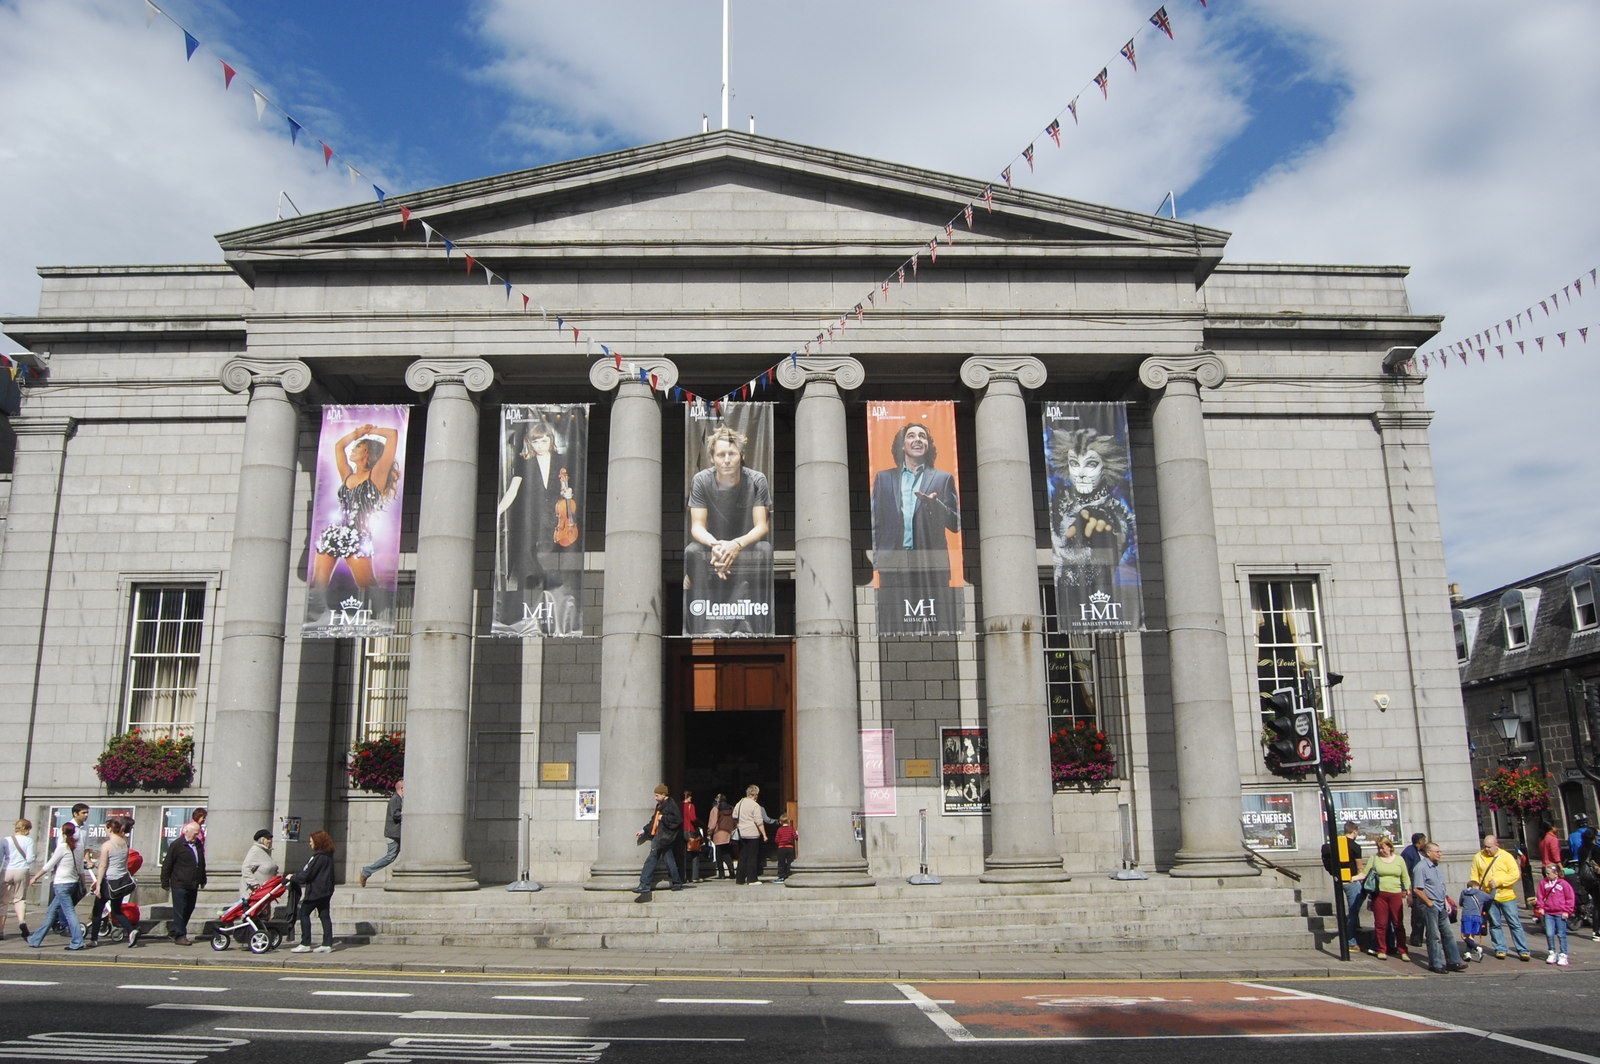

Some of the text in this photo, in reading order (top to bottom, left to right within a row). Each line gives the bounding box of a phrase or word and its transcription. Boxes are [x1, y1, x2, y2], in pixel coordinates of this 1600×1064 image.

[521, 602, 555, 620] MH
[705, 600, 769, 616] LemonTree
[903, 598, 936, 616] MH
[1079, 602, 1122, 621] HMT
[328, 609, 373, 626] HMT
[1251, 812, 1293, 824] GATHERERS
[1339, 810, 1358, 821] CONE
[1358, 809, 1398, 821] GATHERERS
